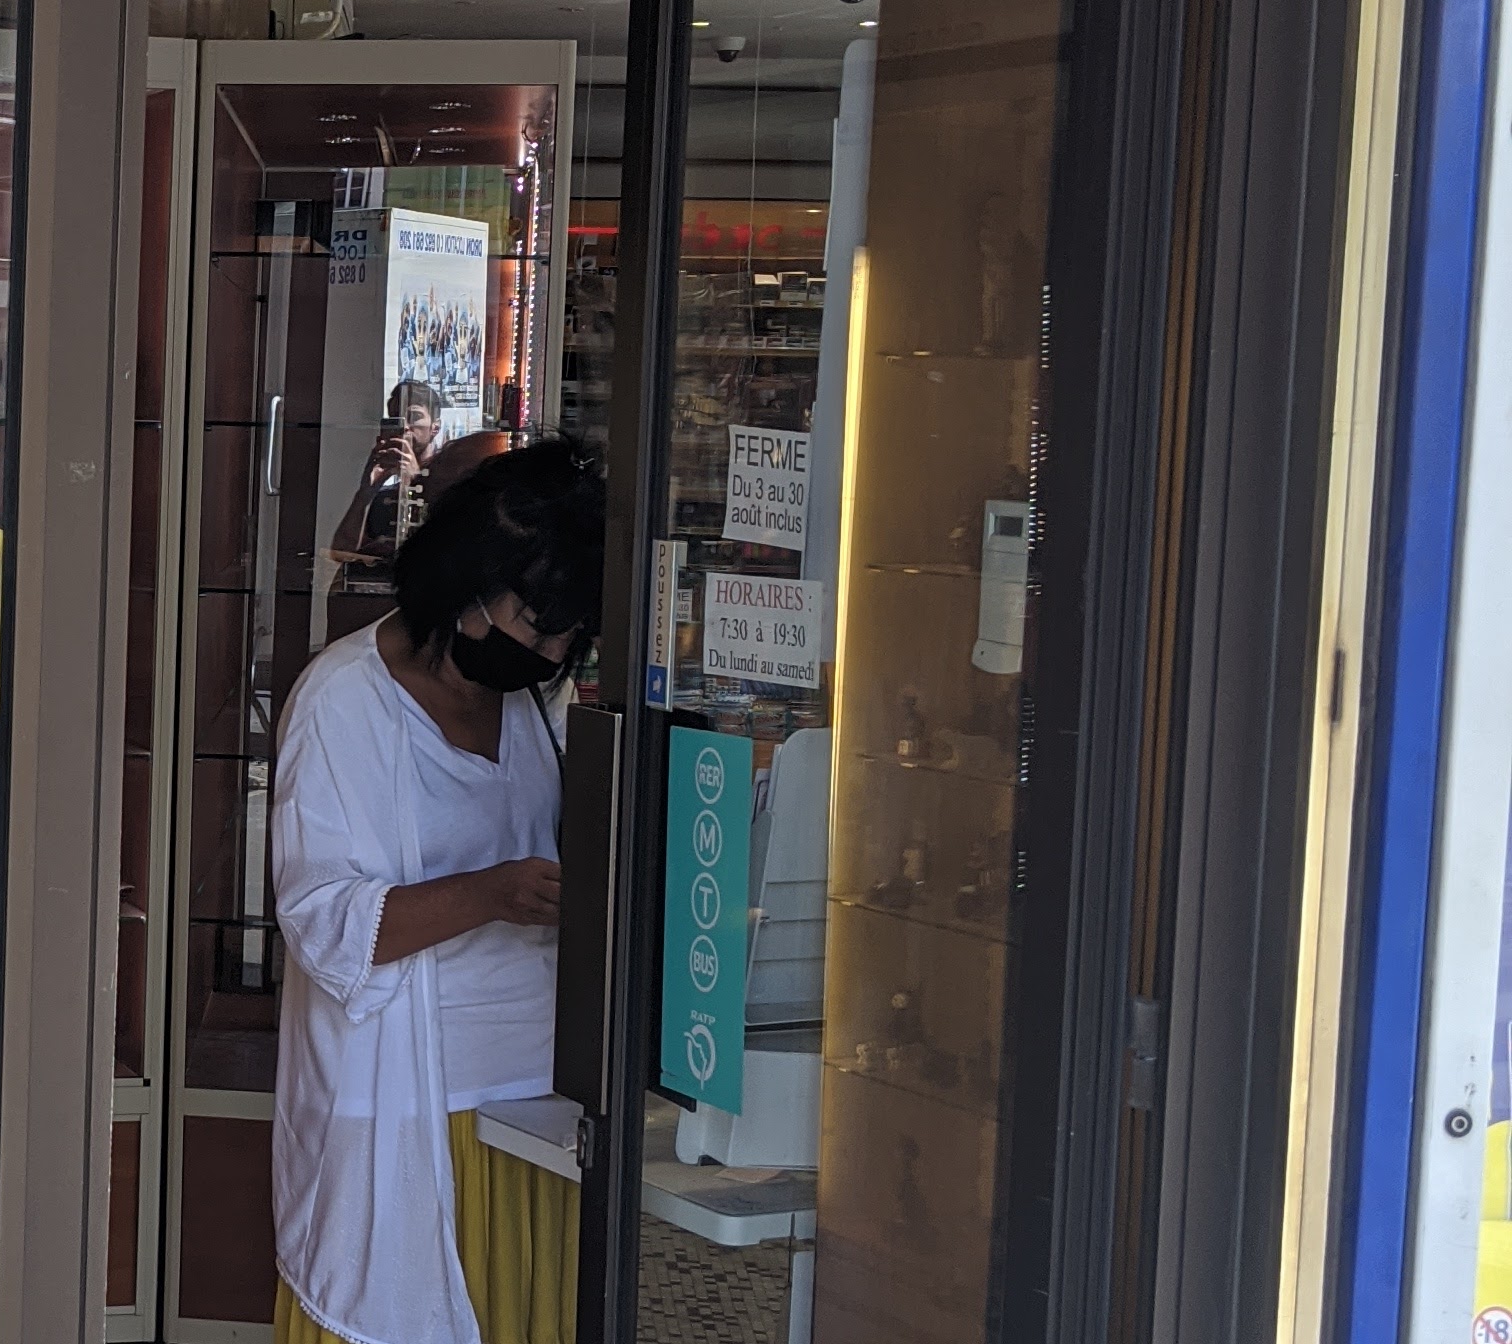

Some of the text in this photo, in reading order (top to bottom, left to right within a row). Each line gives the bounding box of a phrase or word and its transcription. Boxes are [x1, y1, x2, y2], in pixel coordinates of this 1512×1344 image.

[734, 433, 807, 473] FERME
[731, 474, 804, 506] Du 3 au 30
[731, 503, 802, 534] août inclus
[715, 579, 803, 612] HORAIRES
[719, 617, 806, 648] 7:30 à 19:30
[708, 648, 815, 682] Du lundi au samedi
[699, 763, 721, 788] RER
[699, 821, 716, 856] M
[698, 885, 714, 918] T
[693, 950, 715, 977] BUS
[690, 1009, 716, 1026] RATP
